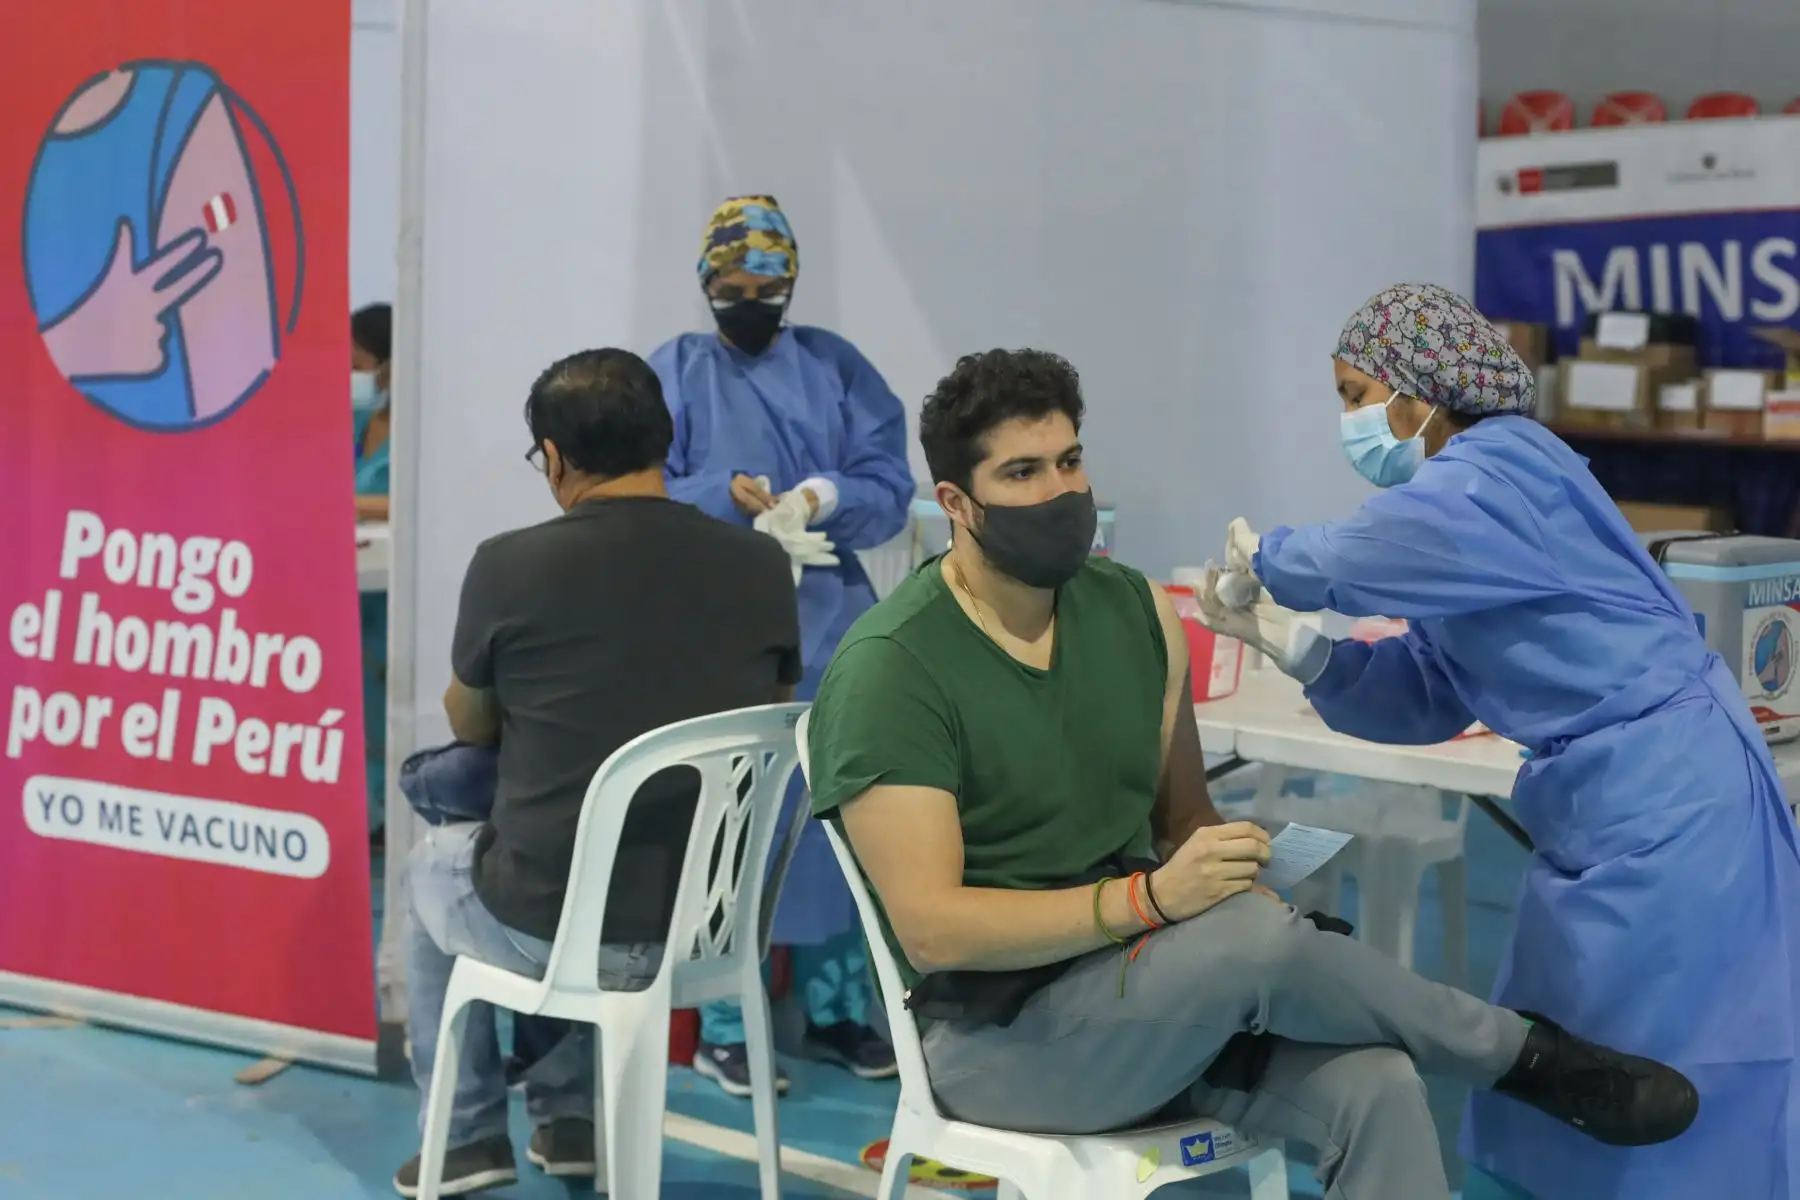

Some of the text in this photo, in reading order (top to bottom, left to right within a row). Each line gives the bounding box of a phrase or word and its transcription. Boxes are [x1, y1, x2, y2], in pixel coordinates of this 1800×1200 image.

[60, 510, 253, 613] Pongo
[10, 589, 322, 693] el hombro
[6, 686, 344, 784] por el Perú
[38, 791, 308, 862] YO ME VACUNO
